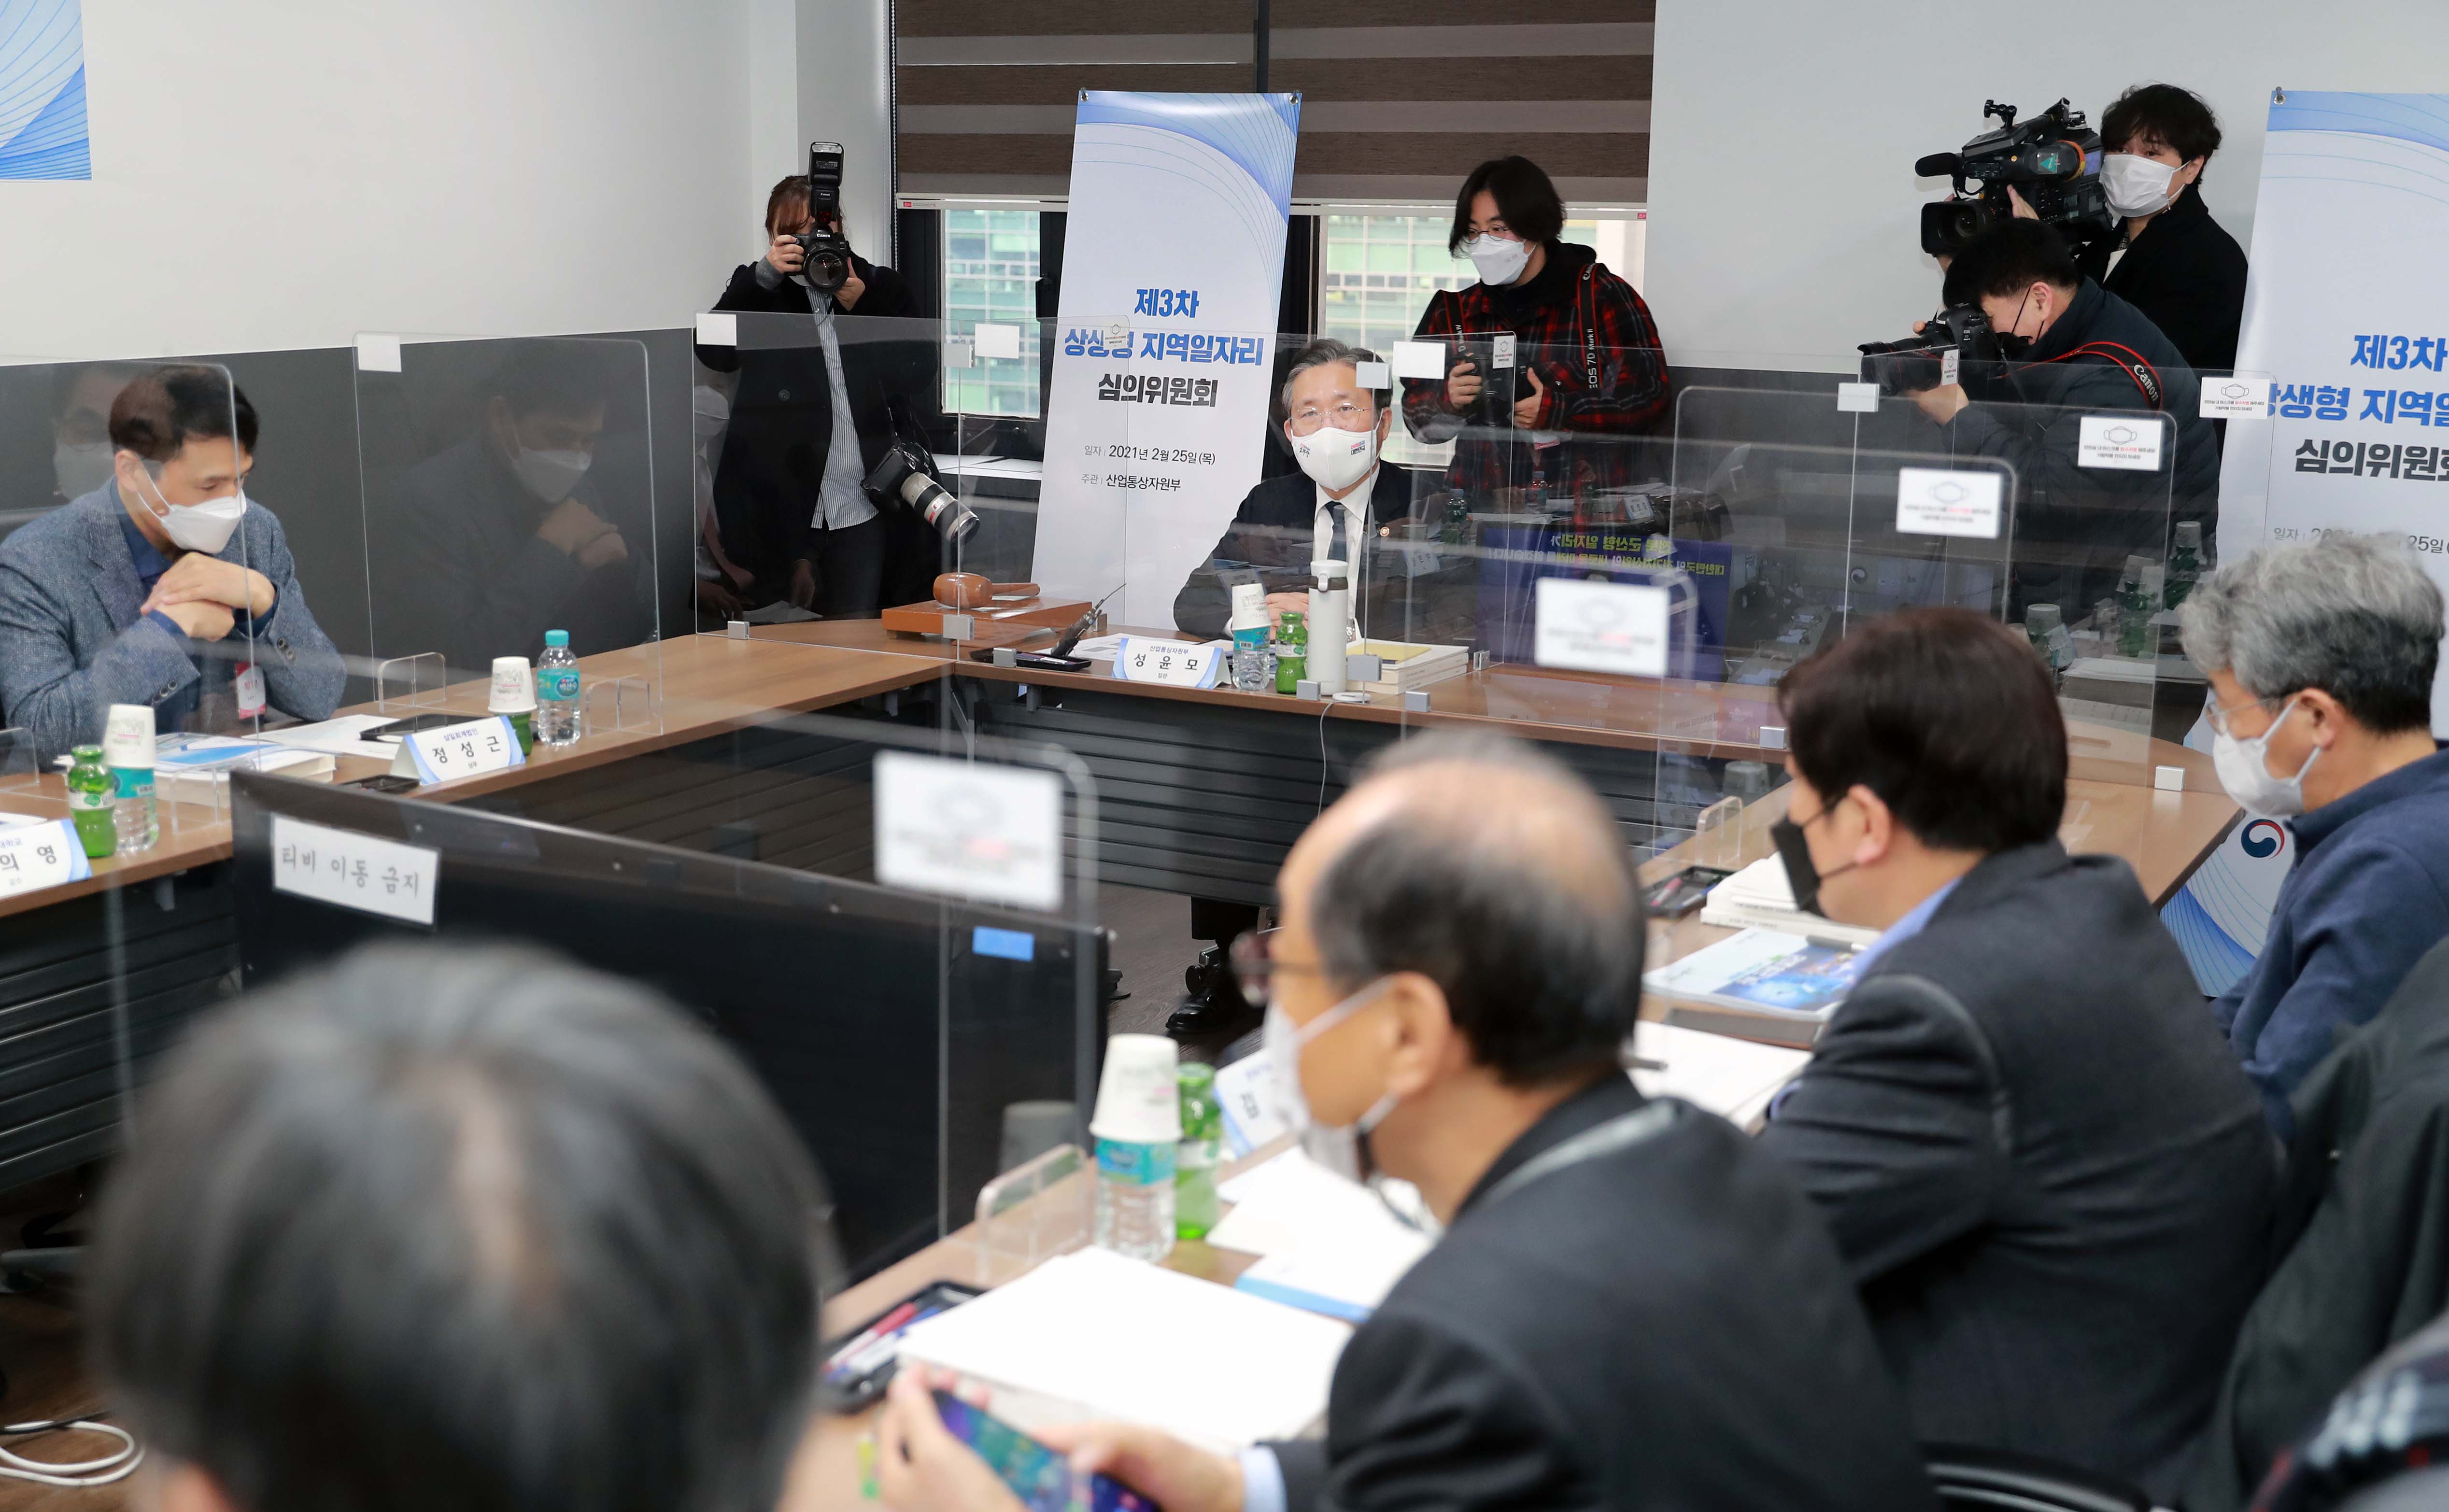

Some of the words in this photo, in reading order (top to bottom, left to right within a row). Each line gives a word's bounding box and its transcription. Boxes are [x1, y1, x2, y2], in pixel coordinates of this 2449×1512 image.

[1134, 288, 1200, 318] 제3차
[1140, 332, 1265, 367] 지역일자리
[1587, 353, 1596, 366] 7D
[2350, 335, 2448, 372] 제3차
[1098, 373, 1218, 407] 심의위원회
[2134, 364, 2159, 402] Canon
[1084, 445, 1102, 456] 일자
[1108, 444, 1148, 460] 2021년
[1151, 448, 1169, 462] 2월
[1172, 449, 1216, 466] 25일(목)
[1081, 473, 1099, 485] 주관
[1105, 474, 1181, 492] 산업통상자원부
[2274, 527, 2299, 541] 일자
[1134, 653, 1147, 667] 성
[1159, 656, 1172, 670] 윤
[1185, 659, 1198, 670] 모
[1149, 645, 1189, 655] 산업통상자원부
[432, 747, 448, 764] 정
[461, 741, 475, 758] 성
[486, 735, 501, 753] 근
[331, 855, 368, 888] 이동
[381, 866, 419, 898] 금지
